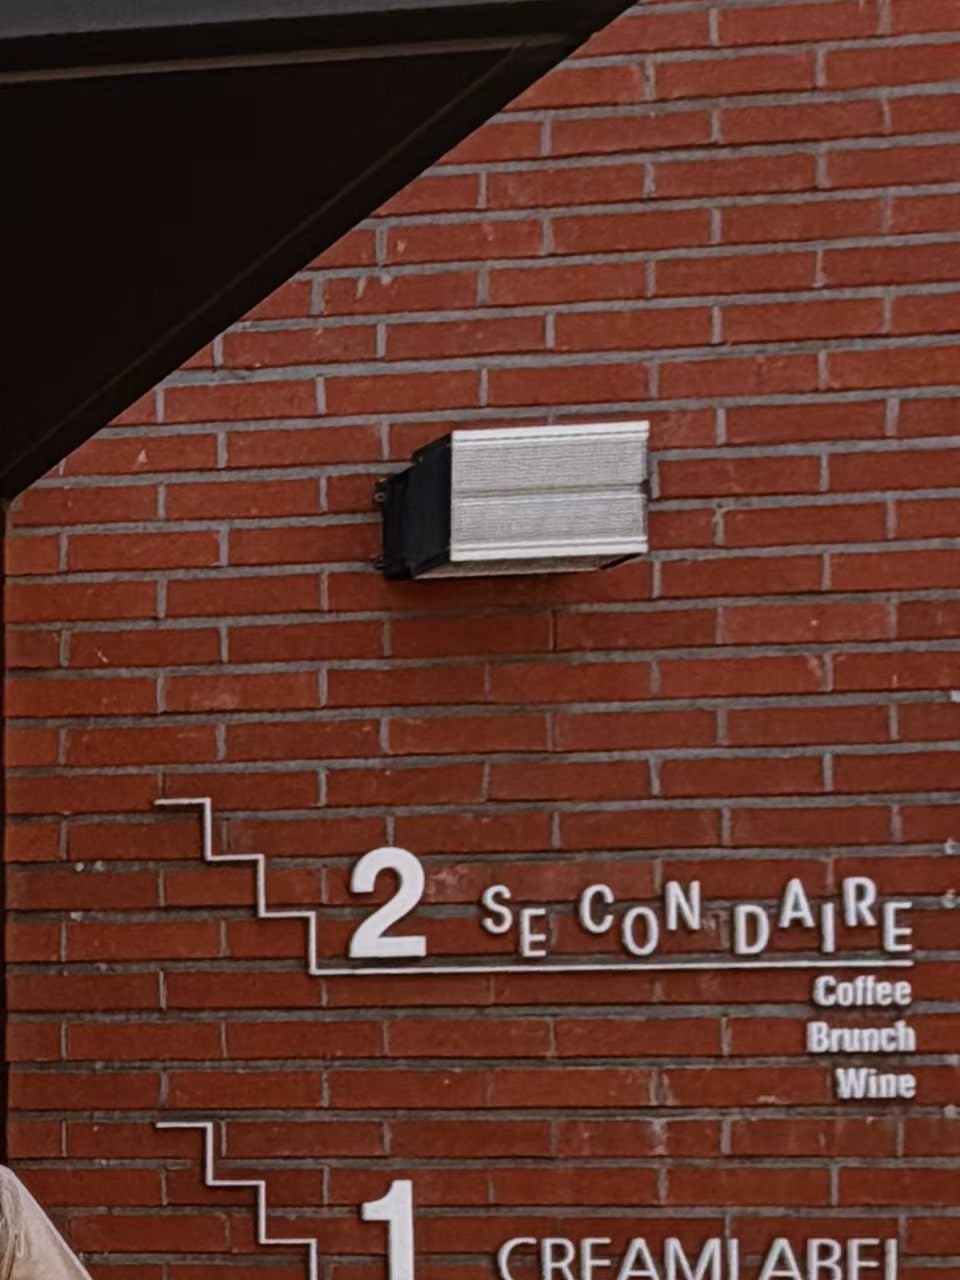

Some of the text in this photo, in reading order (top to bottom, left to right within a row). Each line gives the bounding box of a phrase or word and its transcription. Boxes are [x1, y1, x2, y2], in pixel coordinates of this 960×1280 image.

[349, 846, 427, 958] 2
[482, 876, 913, 958] SE CON DAIRE
[813, 974, 912, 1007] Coffee
[806, 1019, 917, 1053] Brunch
[835, 1067, 917, 1099] Wine
